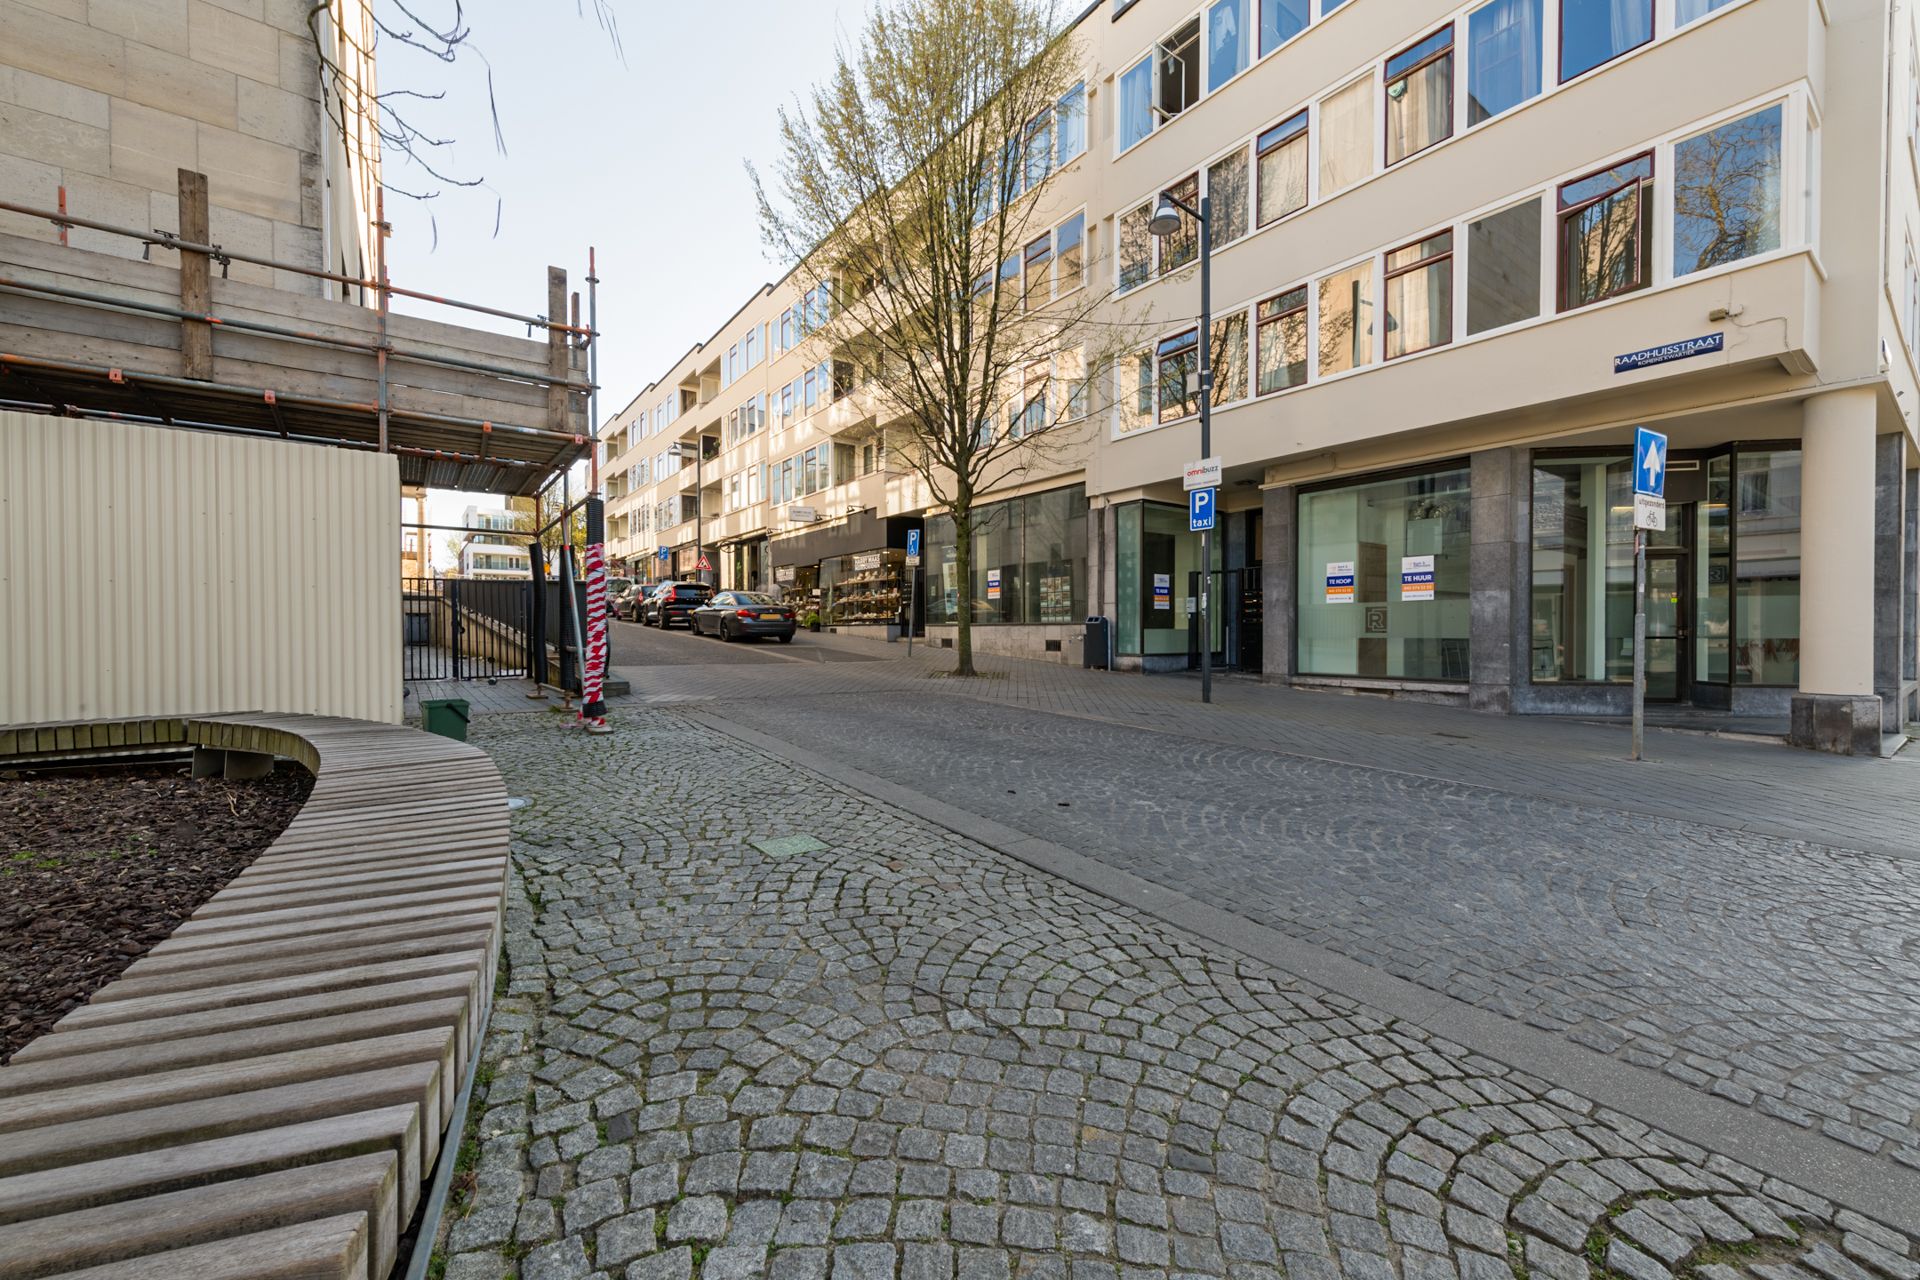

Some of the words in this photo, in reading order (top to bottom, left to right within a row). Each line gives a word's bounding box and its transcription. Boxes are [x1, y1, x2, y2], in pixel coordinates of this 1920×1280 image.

[1614, 334, 1722, 366] RAADHUISSTRAAT
[1663, 350, 1695, 361] KWARTIER
[1187, 465, 1219, 477] omnibuzz
[1195, 492, 1209, 513] P
[1639, 498, 1665, 509] uitgezonderd
[1193, 516, 1211, 527] taxi
[910, 532, 917, 545] P
